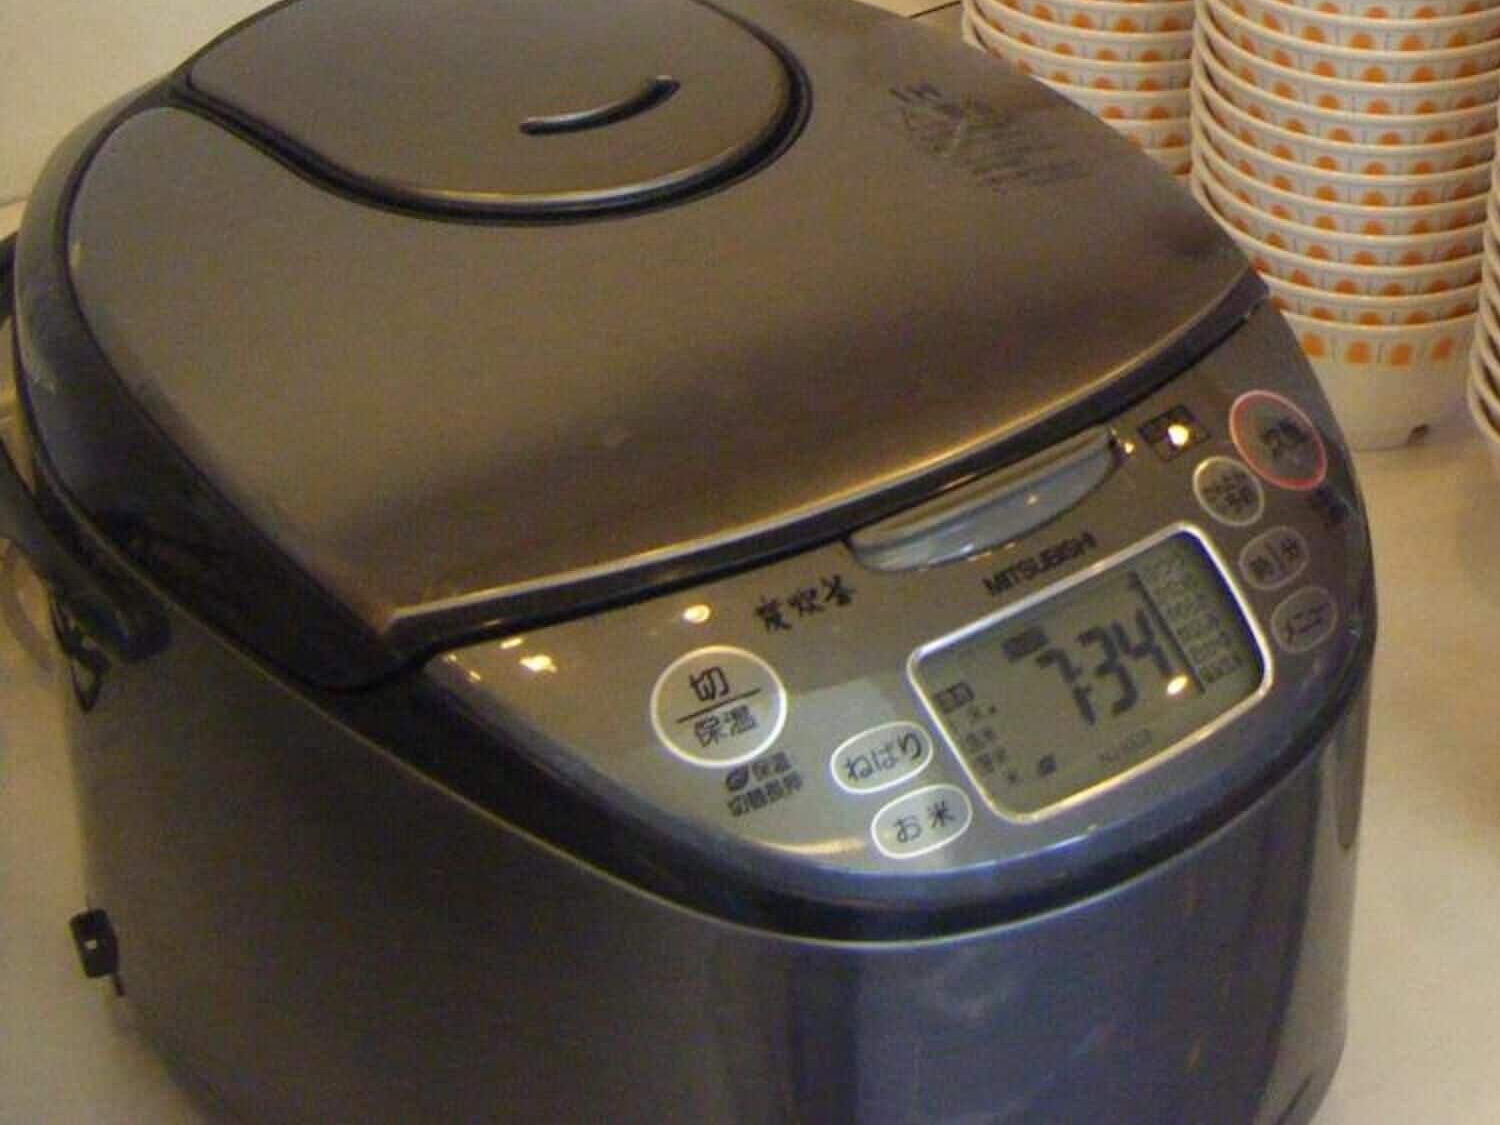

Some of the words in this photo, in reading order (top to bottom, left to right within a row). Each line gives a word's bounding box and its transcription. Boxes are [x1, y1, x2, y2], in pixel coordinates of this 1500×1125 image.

[981, 530, 1098, 596] MITSUBISHI
[689, 665, 730, 702] 切
[692, 704, 757, 749] 保温
[845, 731, 923, 782] ねばり
[893, 800, 954, 844] お米
